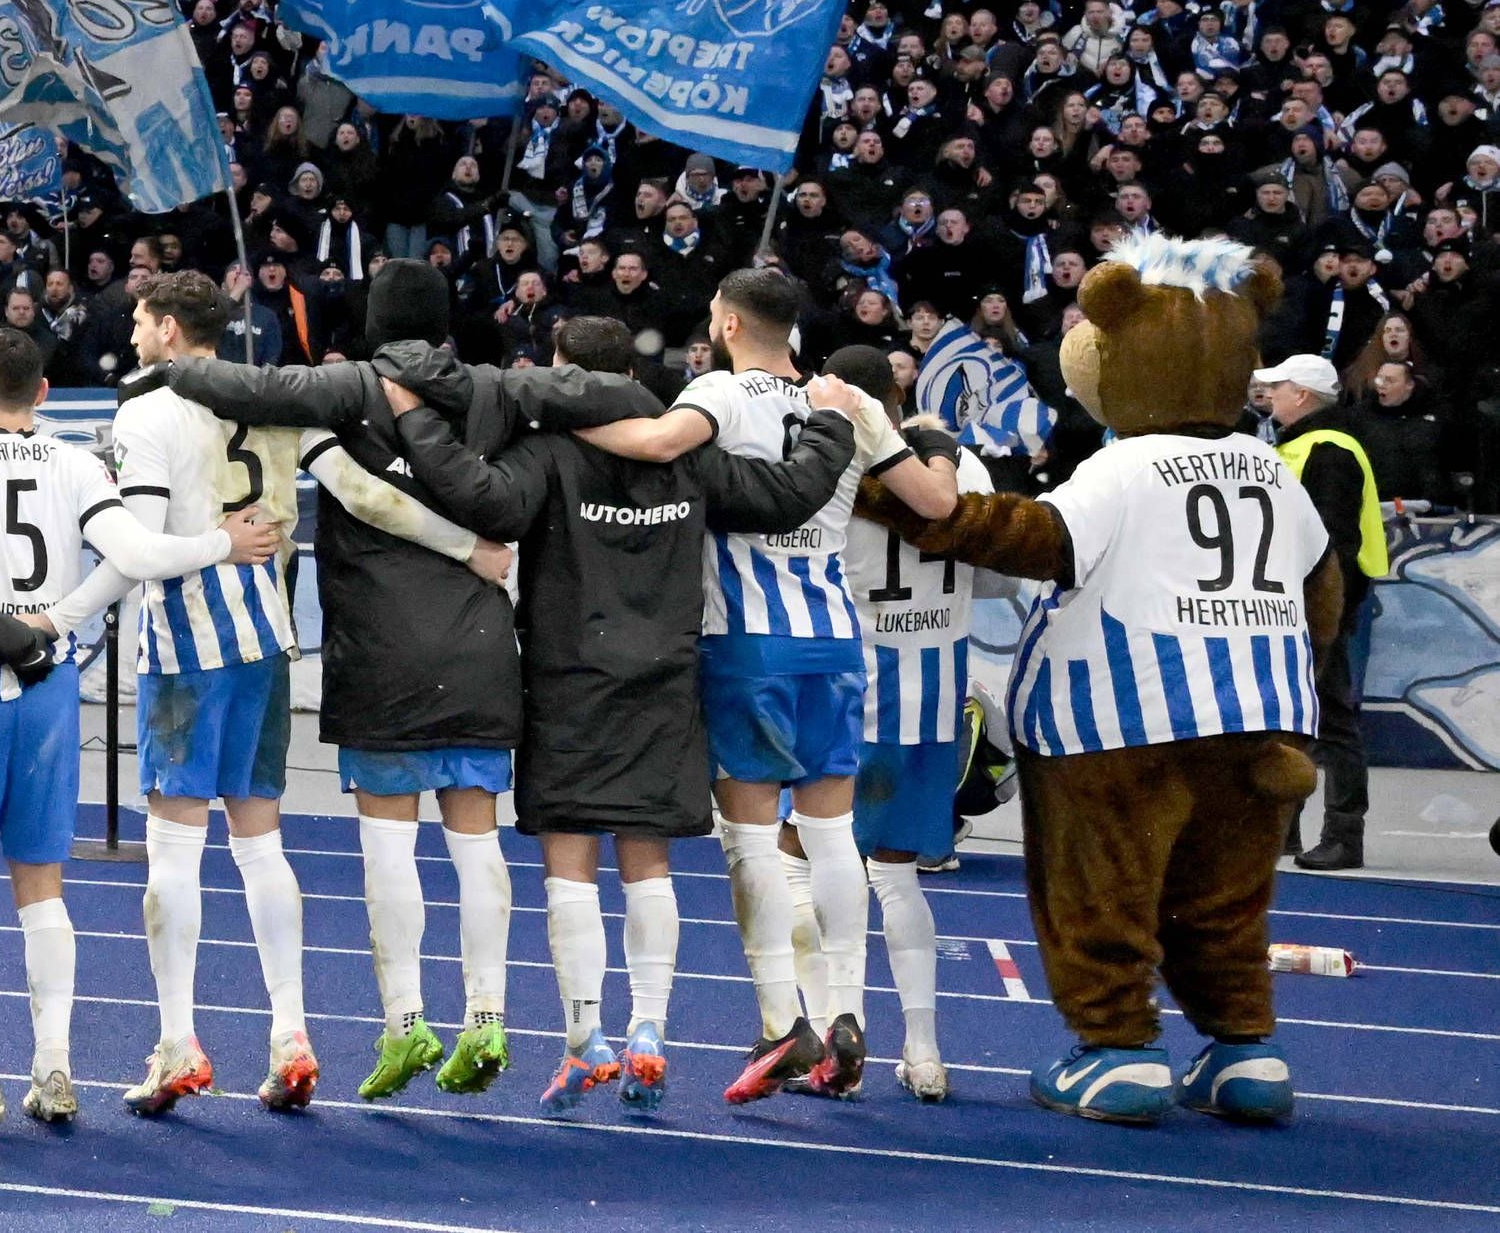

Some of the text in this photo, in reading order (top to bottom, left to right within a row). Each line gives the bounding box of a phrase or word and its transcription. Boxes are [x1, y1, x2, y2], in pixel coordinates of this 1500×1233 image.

[1152, 451, 1283, 490] HERTHA BSC
[580, 499, 691, 526] AUTOHERO
[6, 478, 49, 592] 5
[1185, 483, 1286, 595] 92
[875, 607, 951, 633] LUKÉBAKIO
[1176, 595, 1298, 628] HERTHINHO
